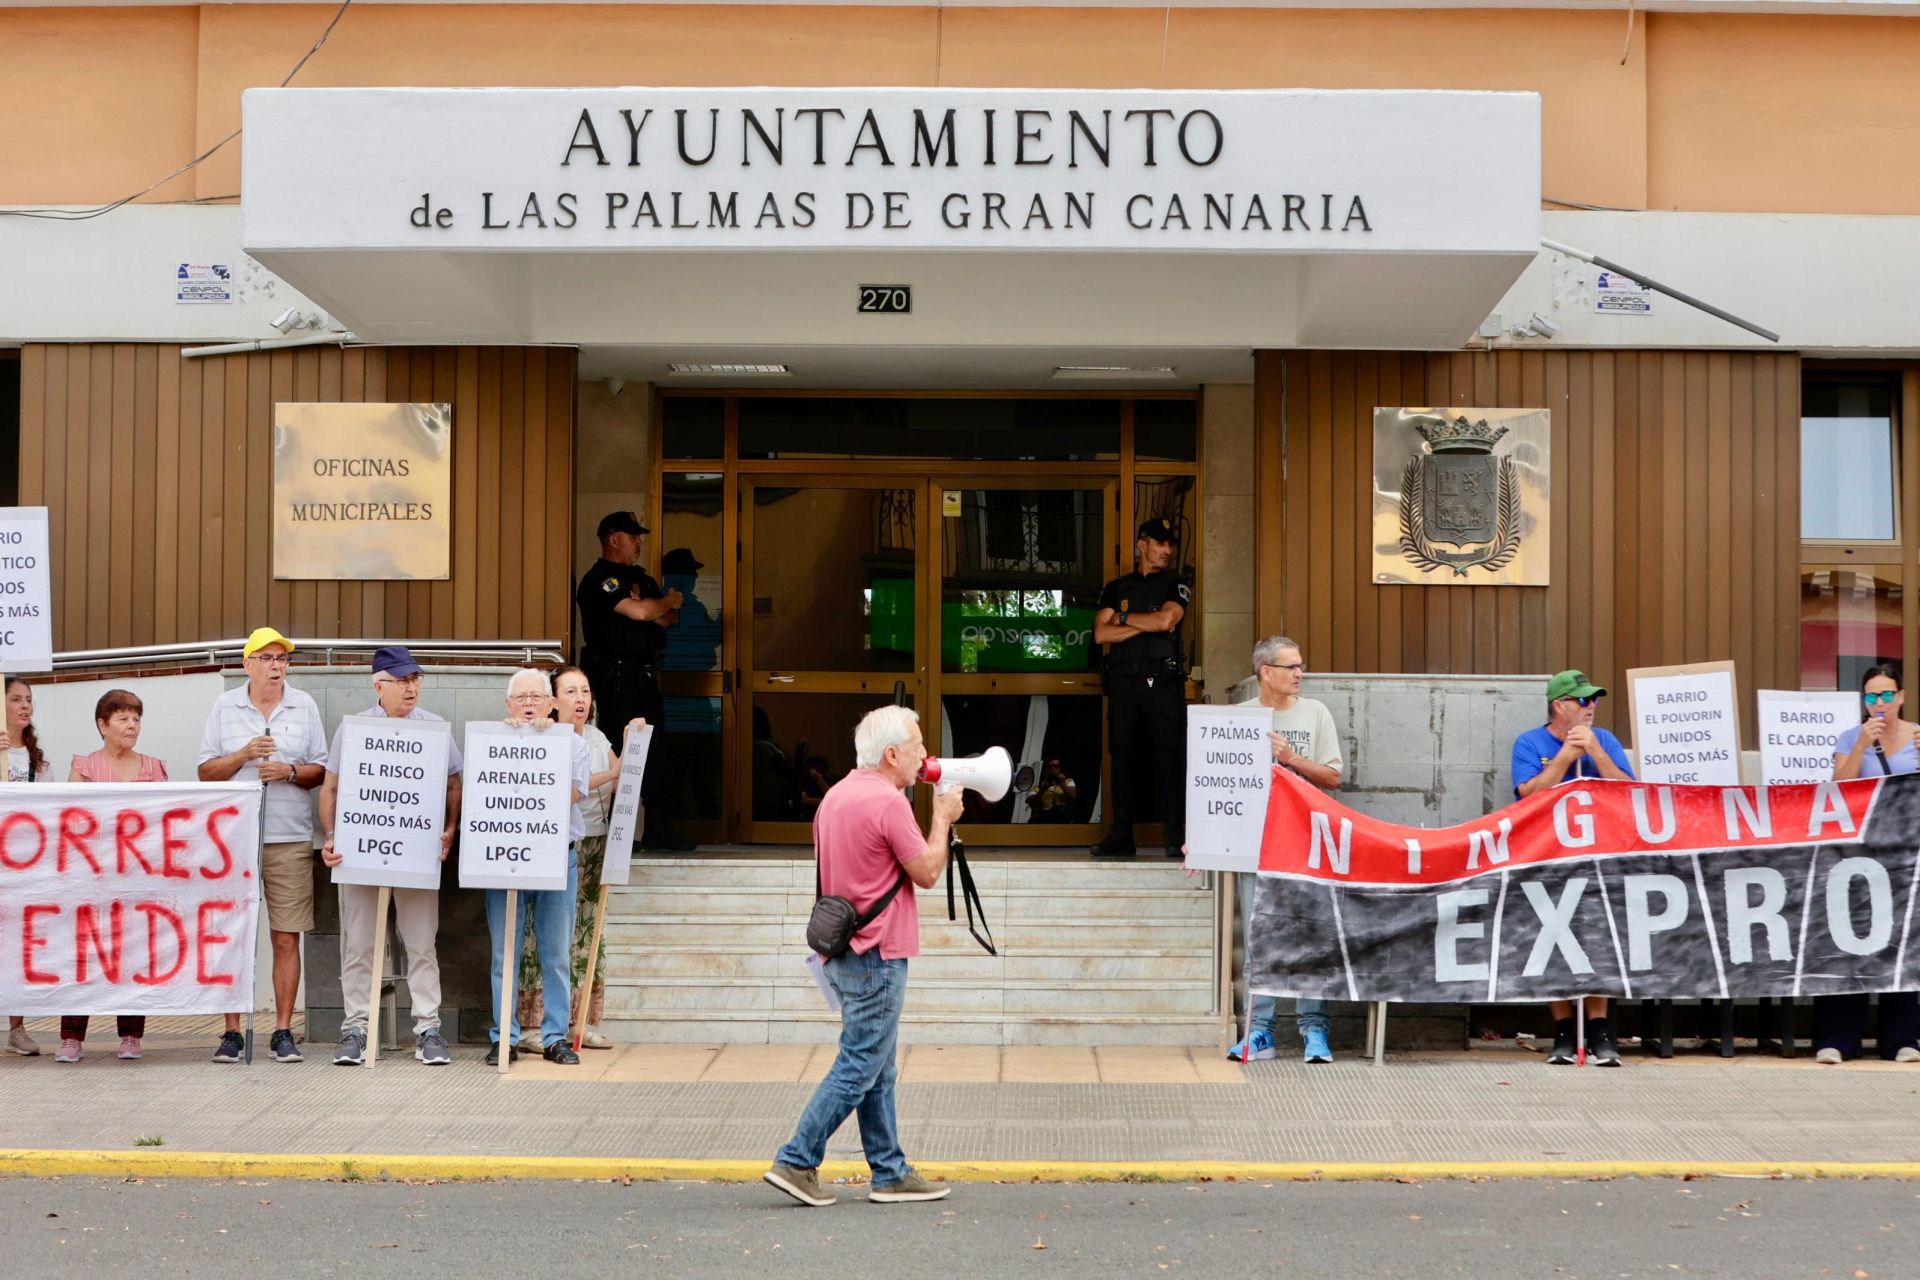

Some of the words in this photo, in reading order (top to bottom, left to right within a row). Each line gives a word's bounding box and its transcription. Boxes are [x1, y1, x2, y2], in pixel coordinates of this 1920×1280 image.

[561, 108, 1224, 167] AYUNTAMIENTO
[410, 192, 454, 229] de
[481, 191, 578, 229] LAS
[605, 191, 816, 229] PALMAS
[845, 191, 912, 229] DE
[941, 192, 1095, 230] GRAN
[1126, 193, 1373, 231] CANARIA
[863, 289, 907, 310] 270
[313, 458, 410, 477] OFICINAS
[292, 502, 433, 522] MUNICIPALES
[1, 556, 36, 570] TICO
[8, 603, 40, 618] MÁS
[1657, 690, 1708, 705] BARRIO
[1645, 714, 1660, 725] EL
[1661, 709, 1722, 724] POLVORIN
[1780, 711, 1835, 724] BARRIO
[1200, 727, 1208, 739] 7
[1211, 727, 1260, 740] PALMAS
[1274, 730, 1310, 742] SITIVE
[1658, 730, 1712, 744] UNIDOS
[1768, 733, 1784, 745] EL
[365, 737, 423, 754] BARRIO
[489, 746, 547, 760] BARRIO
[1206, 752, 1254, 765] UNIDOS
[1644, 752, 1695, 765] SOMOS
[1698, 748, 1729, 762] MÁS
[359, 762, 375, 776] EL
[379, 764, 425, 780] RISCO
[477, 771, 556, 786] ARENALES
[1668, 772, 1699, 783] LPGC
[1194, 776, 1236, 789] SOMOS
[1239, 774, 1264, 790] MÁS
[359, 788, 420, 805] UNIDOS
[485, 797, 546, 811] UNIDOS
[1208, 800, 1244, 816] LPGC
[343, 811, 395, 827] SOMOS
[399, 815, 432, 830] MÁS
[469, 820, 522, 834] SOMOS
[526, 820, 559, 835] MÁS
[1308, 782, 1858, 875] NINGUNA
[358, 838, 404, 856] LPGC
[486, 846, 532, 862] LPGC
[1434, 856, 1894, 983] EXPRO
[22, 900, 235, 985] ENDE
